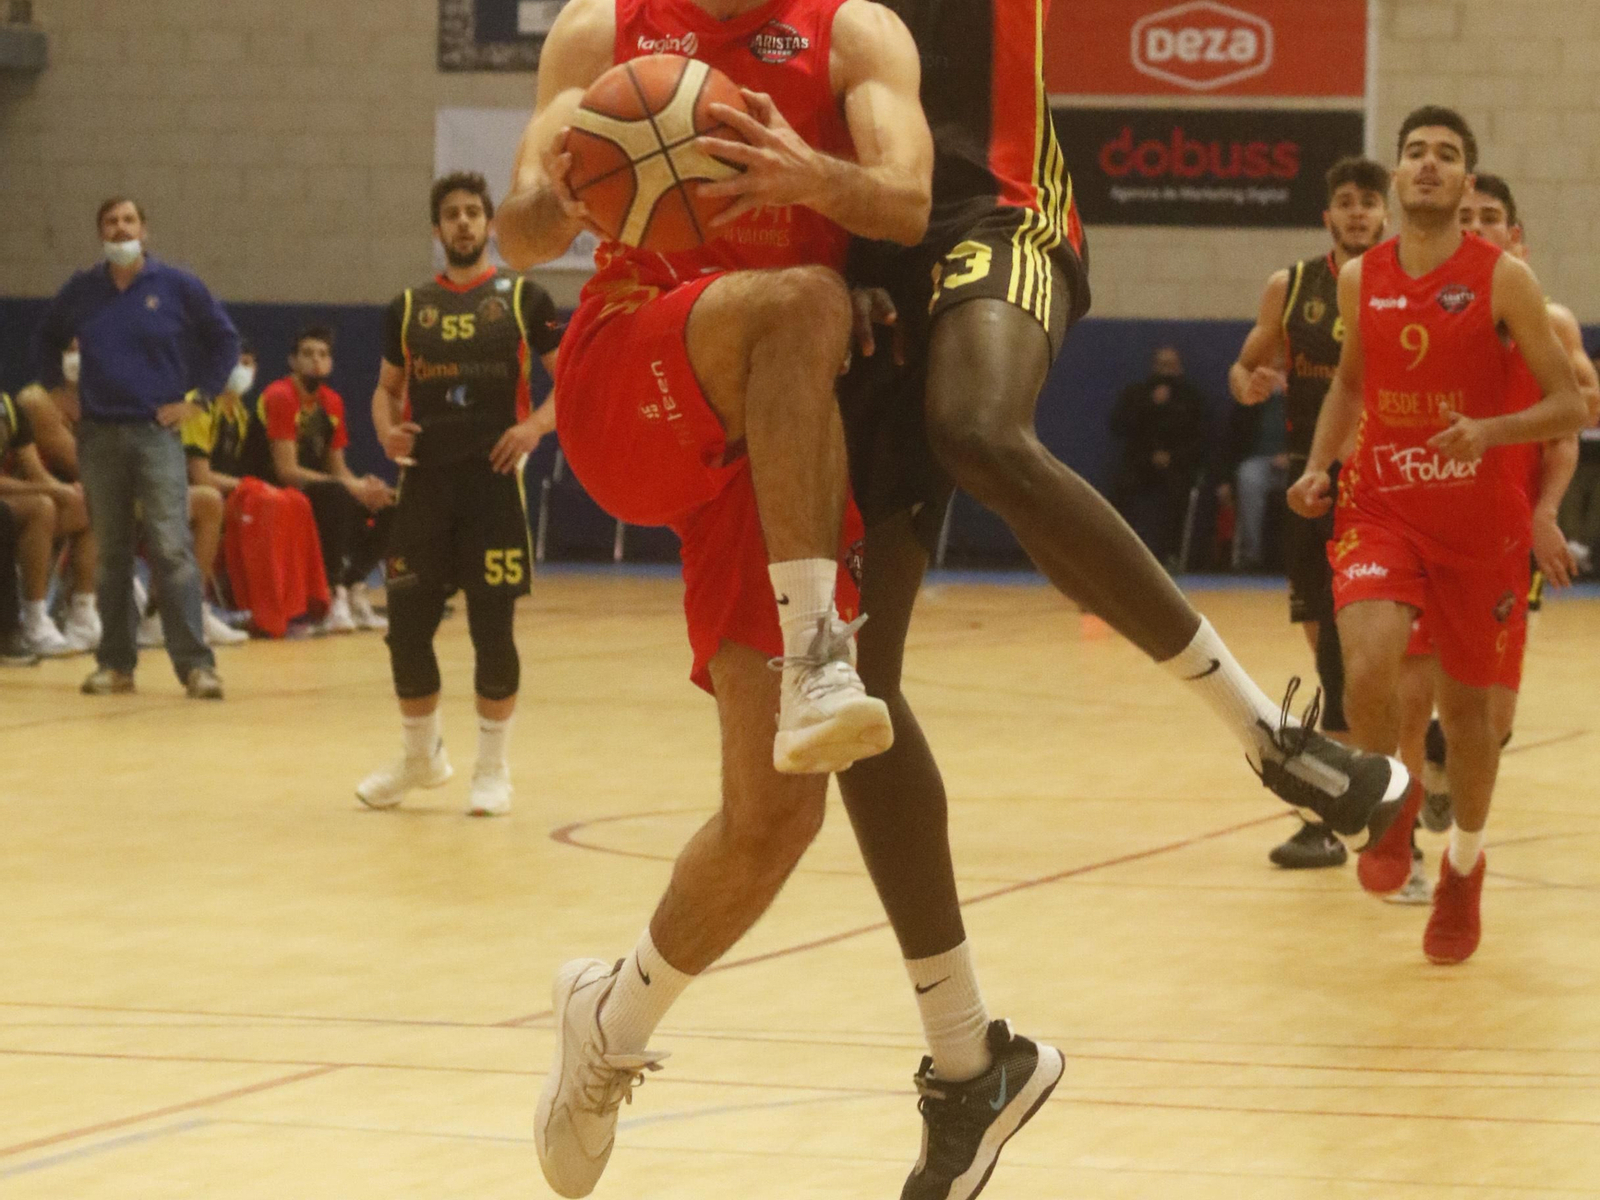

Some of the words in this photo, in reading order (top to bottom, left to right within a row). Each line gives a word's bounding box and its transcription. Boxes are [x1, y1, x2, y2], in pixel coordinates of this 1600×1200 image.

[1098, 126, 1300, 179] dobuss
[441, 313, 476, 341] 55
[1400, 324, 1429, 371] 9
[485, 550, 524, 585] 55
